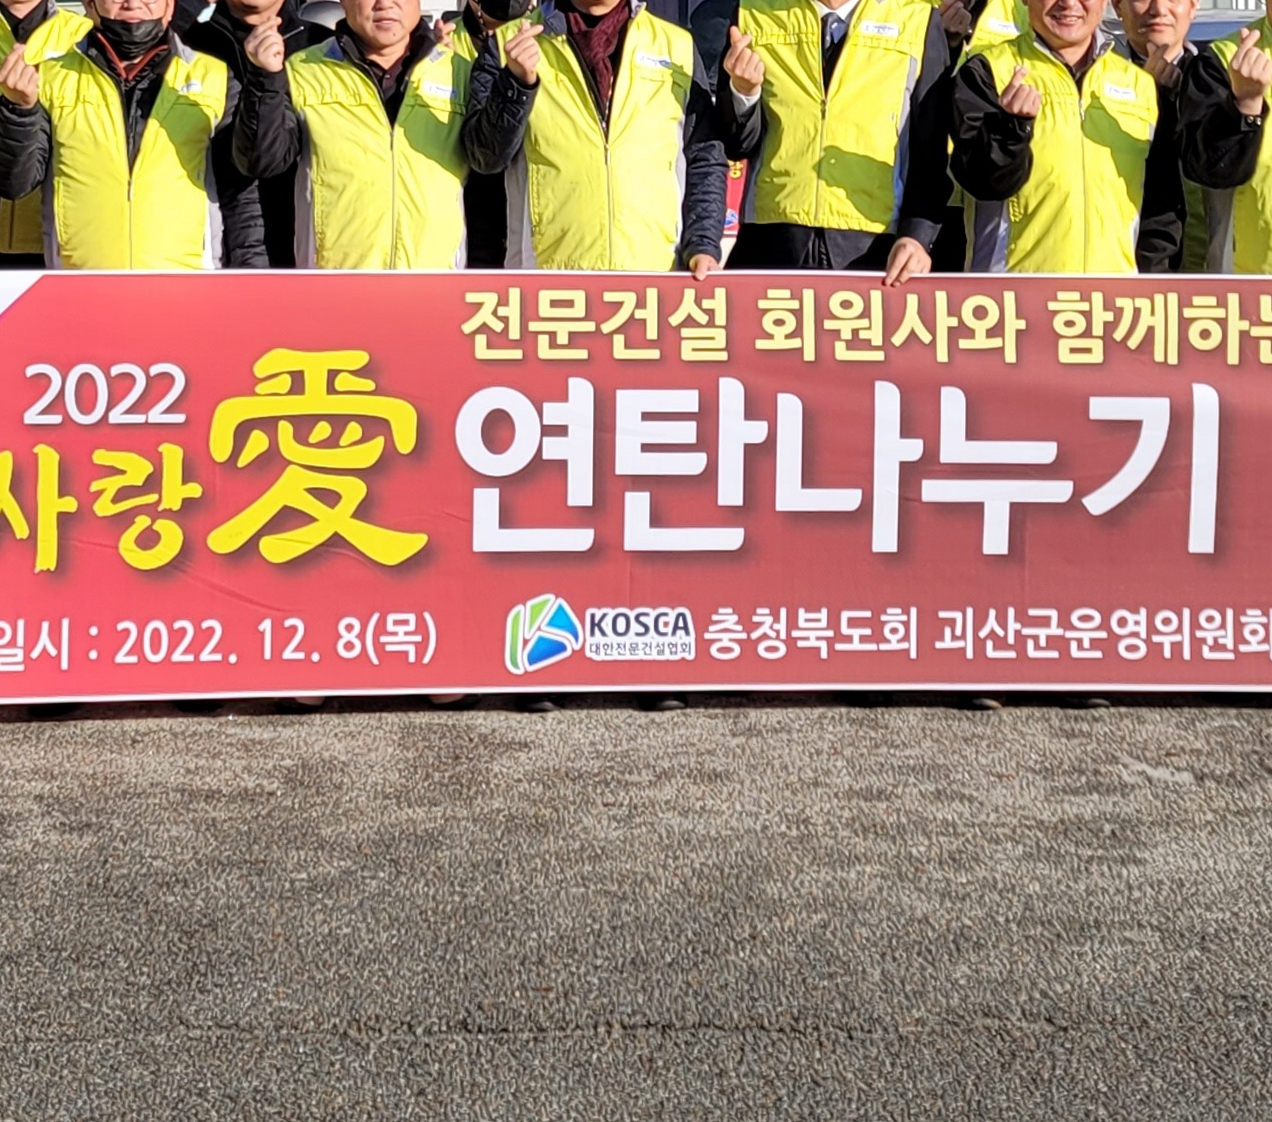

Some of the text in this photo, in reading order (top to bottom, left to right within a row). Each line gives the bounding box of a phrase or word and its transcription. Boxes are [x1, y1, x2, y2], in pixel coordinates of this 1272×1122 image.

[460, 287, 729, 361] 전문건설
[754, 288, 1027, 364] 회원사와
[23, 363, 186, 425] 2022
[456, 377, 1219, 554] 연탄나누기
[115, 619, 237, 664] 2022.
[258, 618, 320, 662] 12.
[337, 612, 437, 665] 8(목)
[589, 642, 692, 656] 대한전문건설협회
[590, 612, 691, 638] KOSCA
[703, 607, 917, 660] 충청북도회
